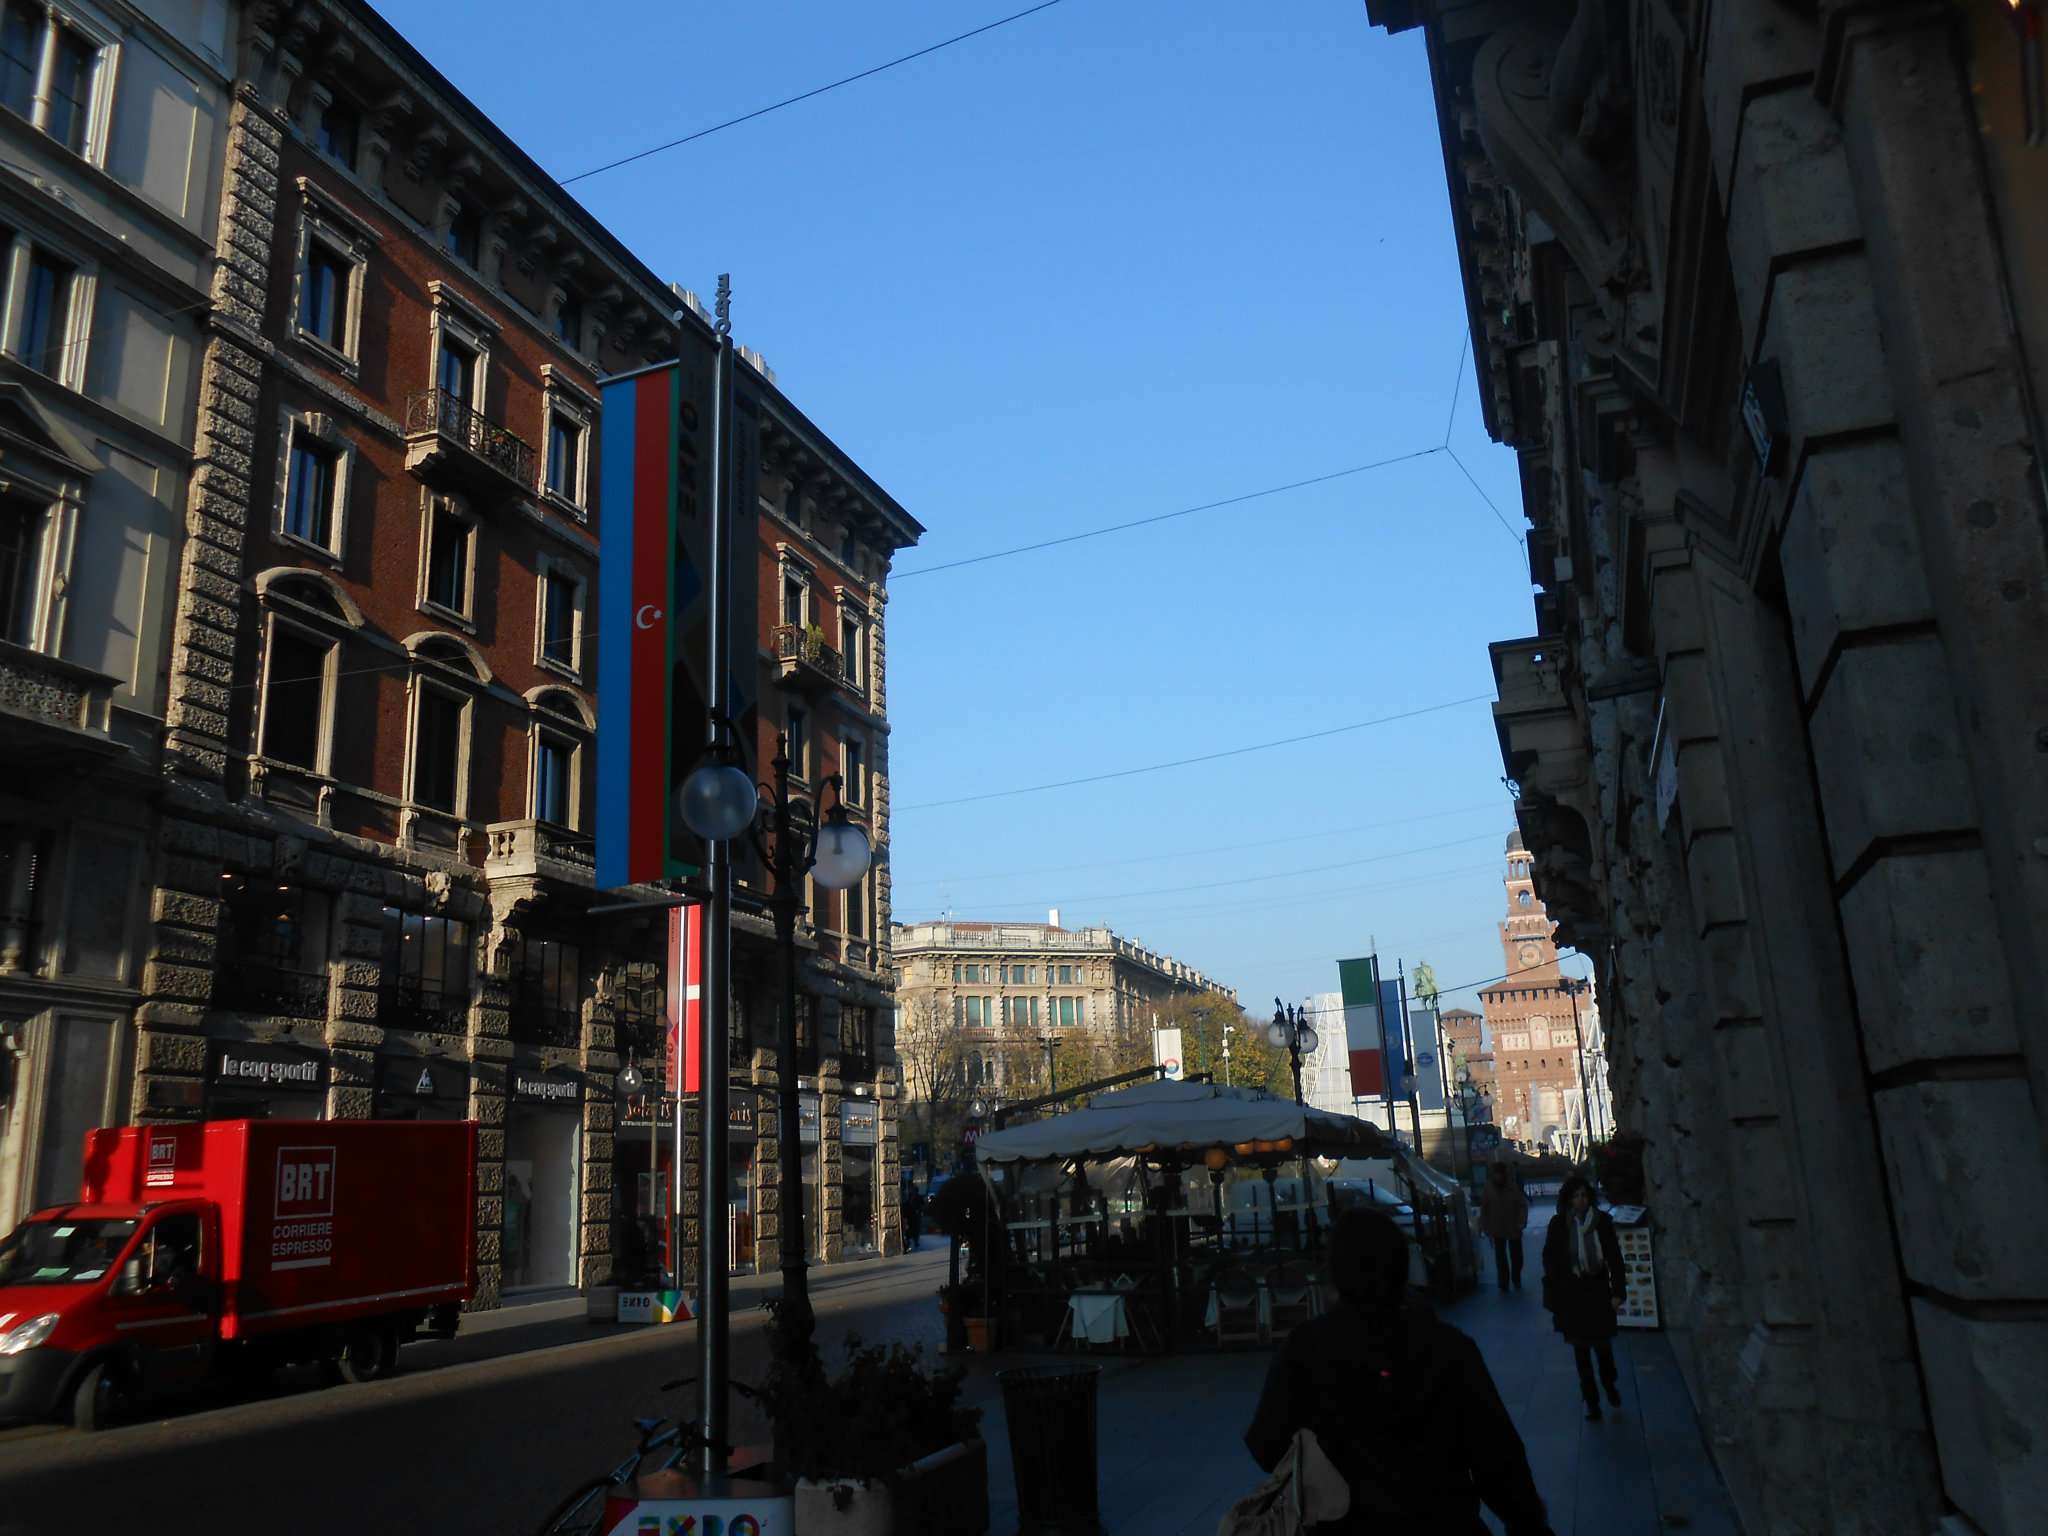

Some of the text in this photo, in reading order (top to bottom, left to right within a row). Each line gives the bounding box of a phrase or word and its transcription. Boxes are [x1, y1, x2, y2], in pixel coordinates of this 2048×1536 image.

[222, 1054, 319, 1083] le coq sportif
[517, 1077, 528, 1094] le
[547, 1081, 578, 1100] sportif
[280, 1162, 330, 1202] BRT
[272, 1222, 333, 1239] CORRIERE
[271, 1238, 333, 1256] ESPRESSO
